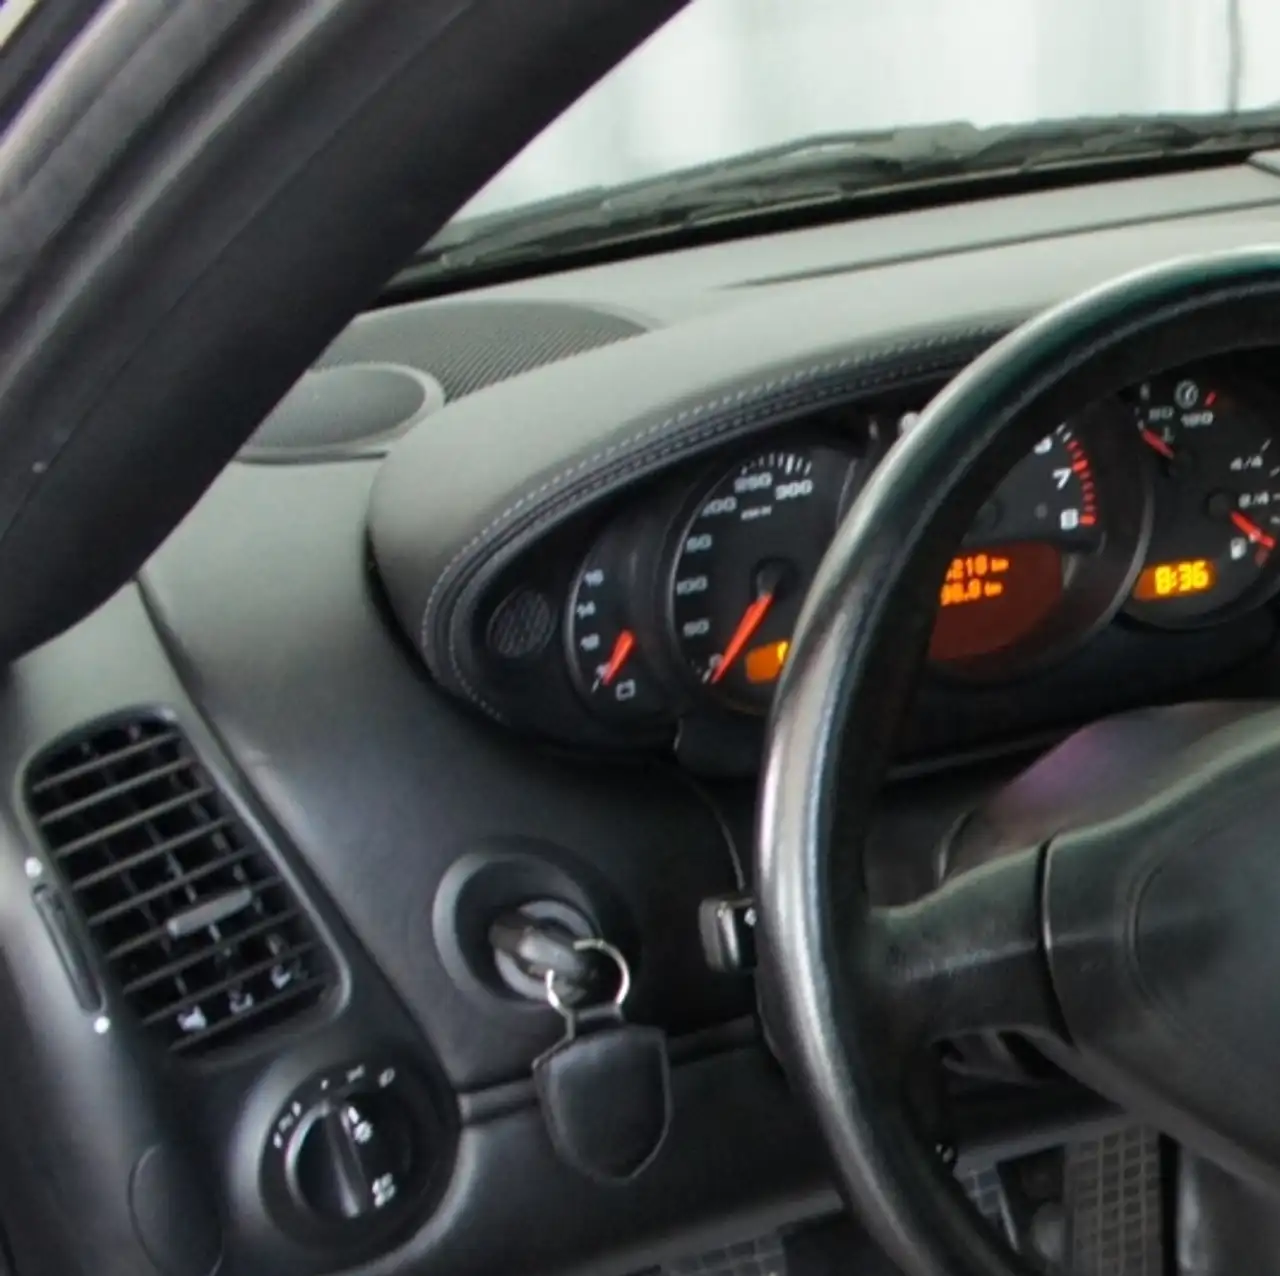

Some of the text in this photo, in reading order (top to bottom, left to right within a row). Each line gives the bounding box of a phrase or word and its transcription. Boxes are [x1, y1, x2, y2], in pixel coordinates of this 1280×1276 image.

[1052, 468, 1072, 489] 7
[1060, 508, 1078, 530] 8
[1154, 559, 1209, 595] 8:36
